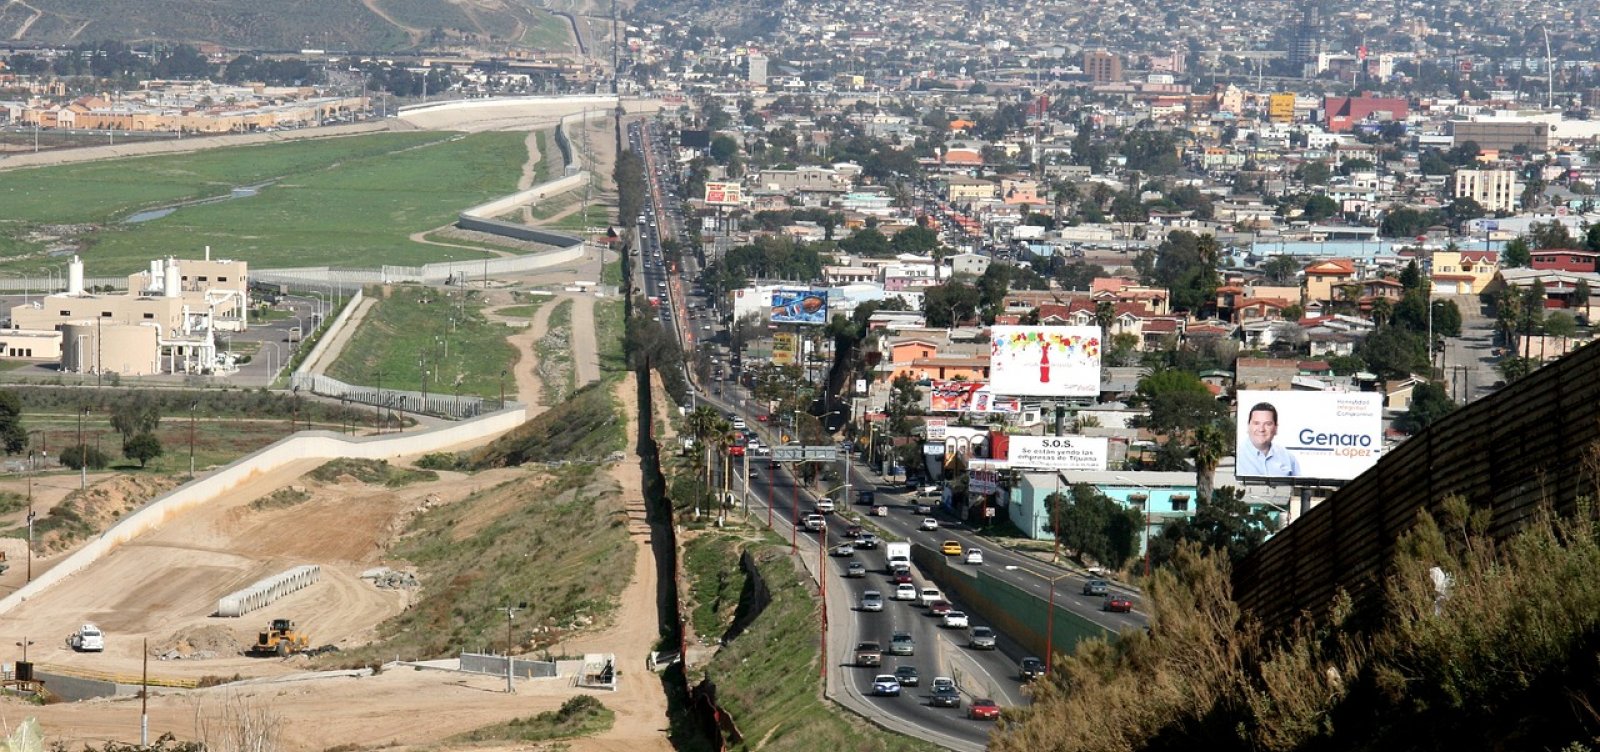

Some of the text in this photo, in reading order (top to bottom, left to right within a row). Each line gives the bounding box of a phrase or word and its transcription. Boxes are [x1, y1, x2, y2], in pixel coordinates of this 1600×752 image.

[1299, 429, 1371, 447] Genaro
[1335, 447, 1371, 458] López
[975, 470, 999, 484] MOTEL
